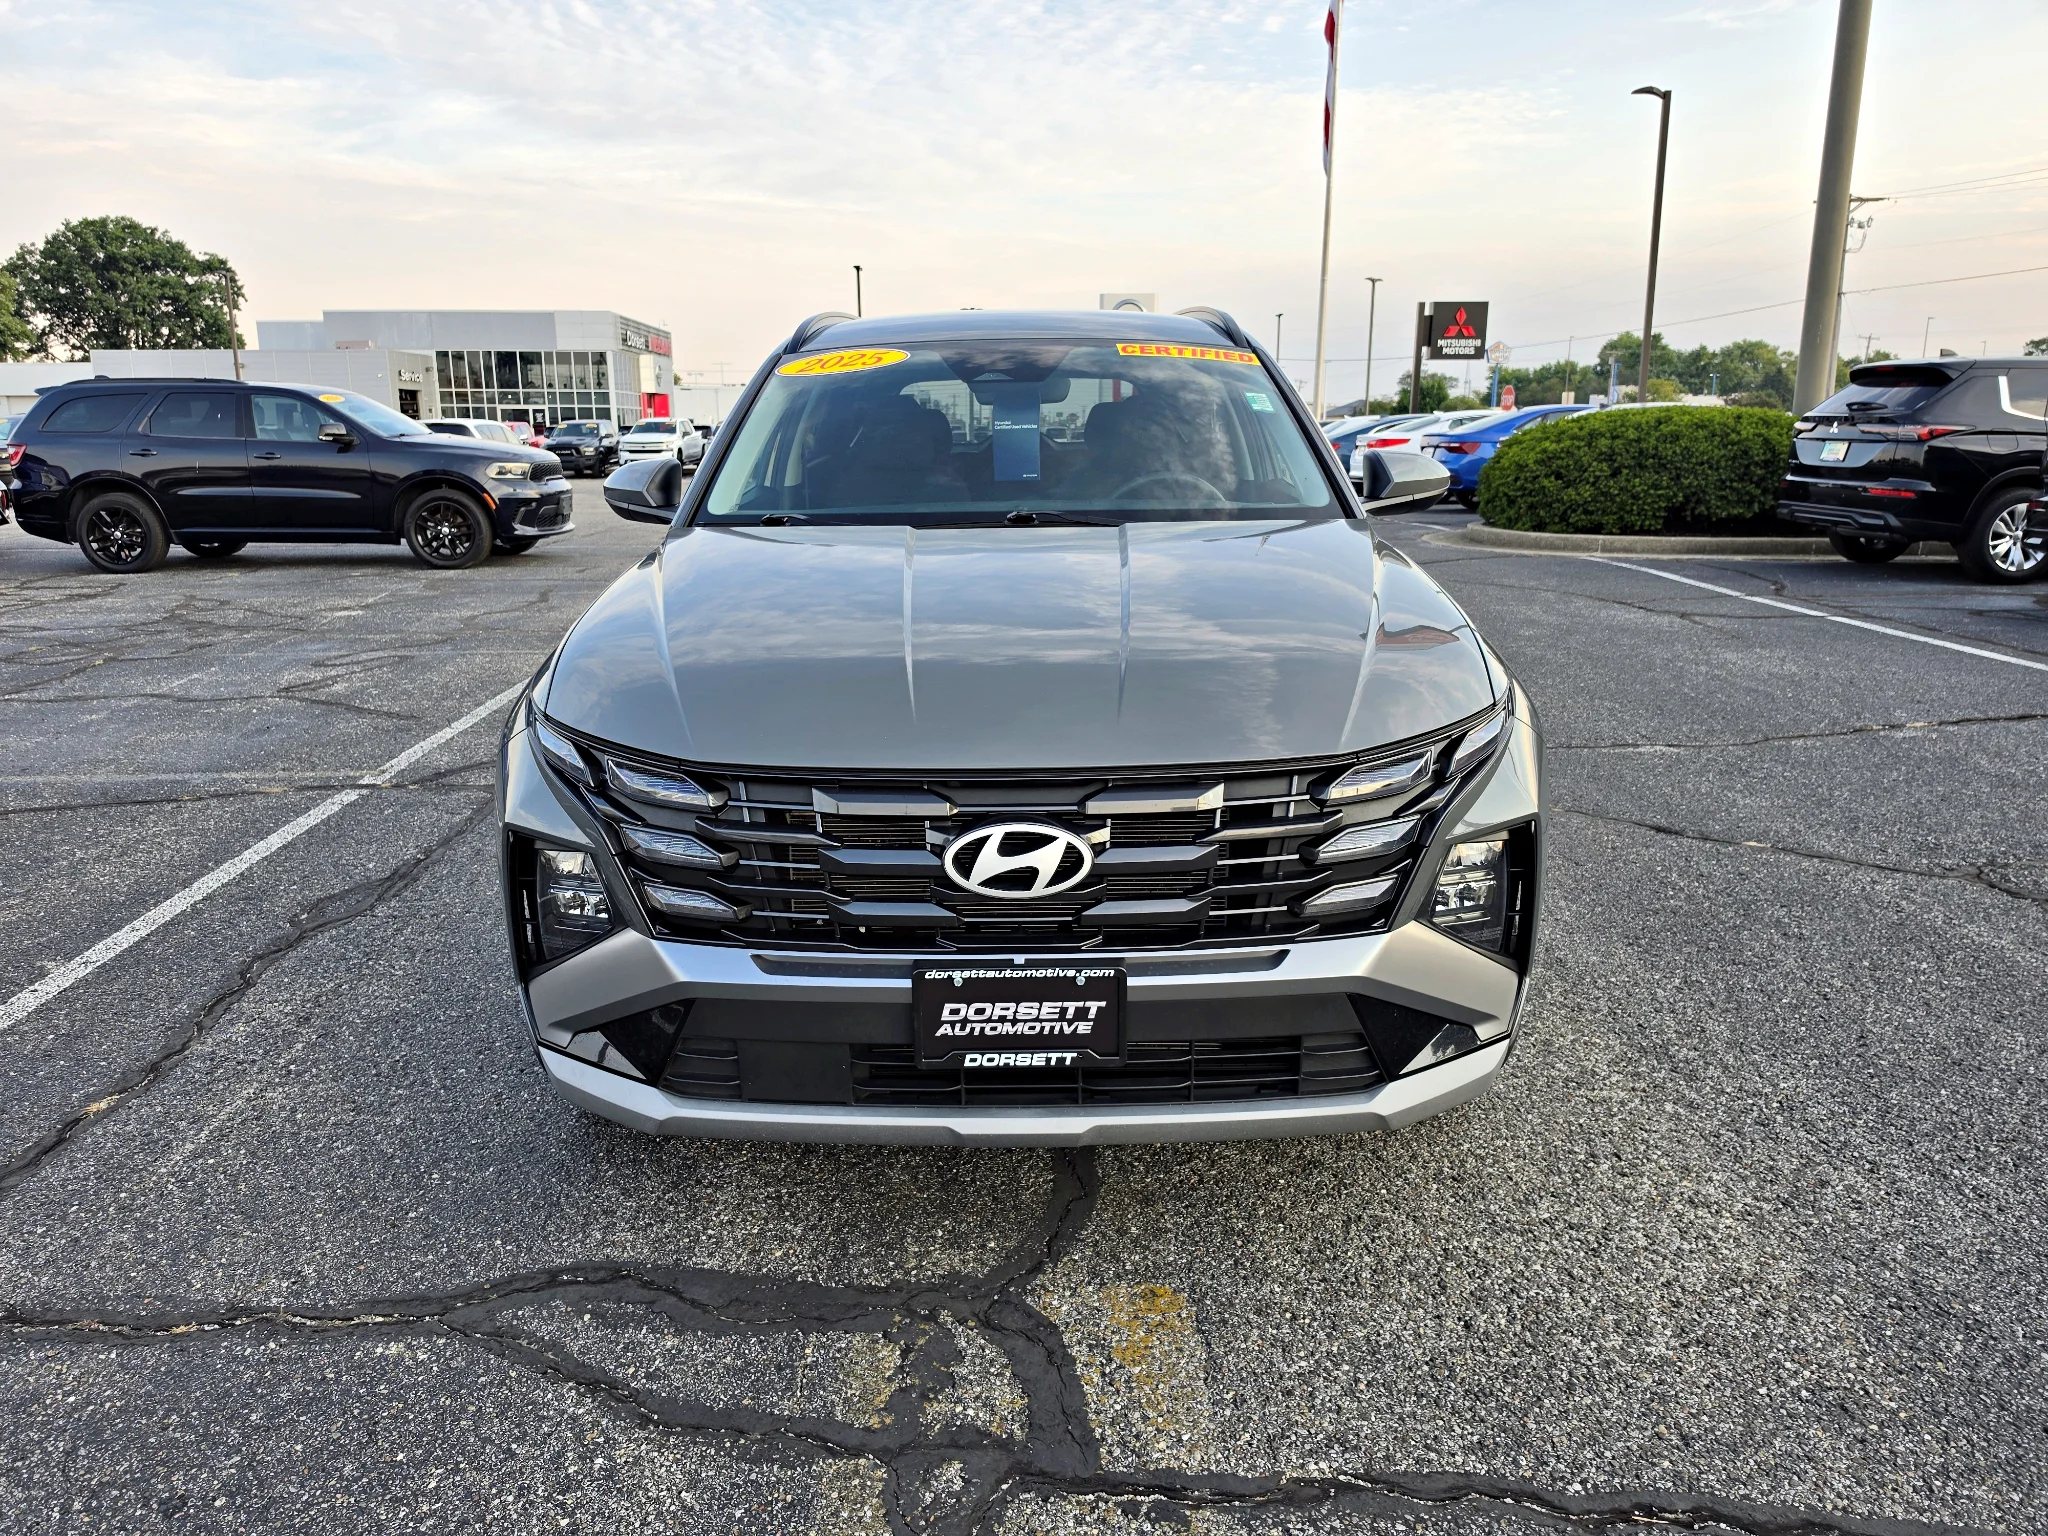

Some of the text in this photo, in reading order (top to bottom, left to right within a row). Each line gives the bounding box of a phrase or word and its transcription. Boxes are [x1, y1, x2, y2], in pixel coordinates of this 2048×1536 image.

[1437, 339, 1482, 347] MITSUBISHI
[1120, 344, 1254, 363] CERTIFIED
[1442, 347, 1475, 355] MOTORS
[796, 352, 890, 373] 2025
[399, 368, 423, 383] Service
[1501, 395, 1514, 406] STOP
[924, 967, 1115, 980] dorsettautomotive.com
[940, 1001, 1107, 1021] DORSETT
[934, 1021, 1094, 1037] AUTOMOTIVE
[963, 1052, 1078, 1067] DORSETT
